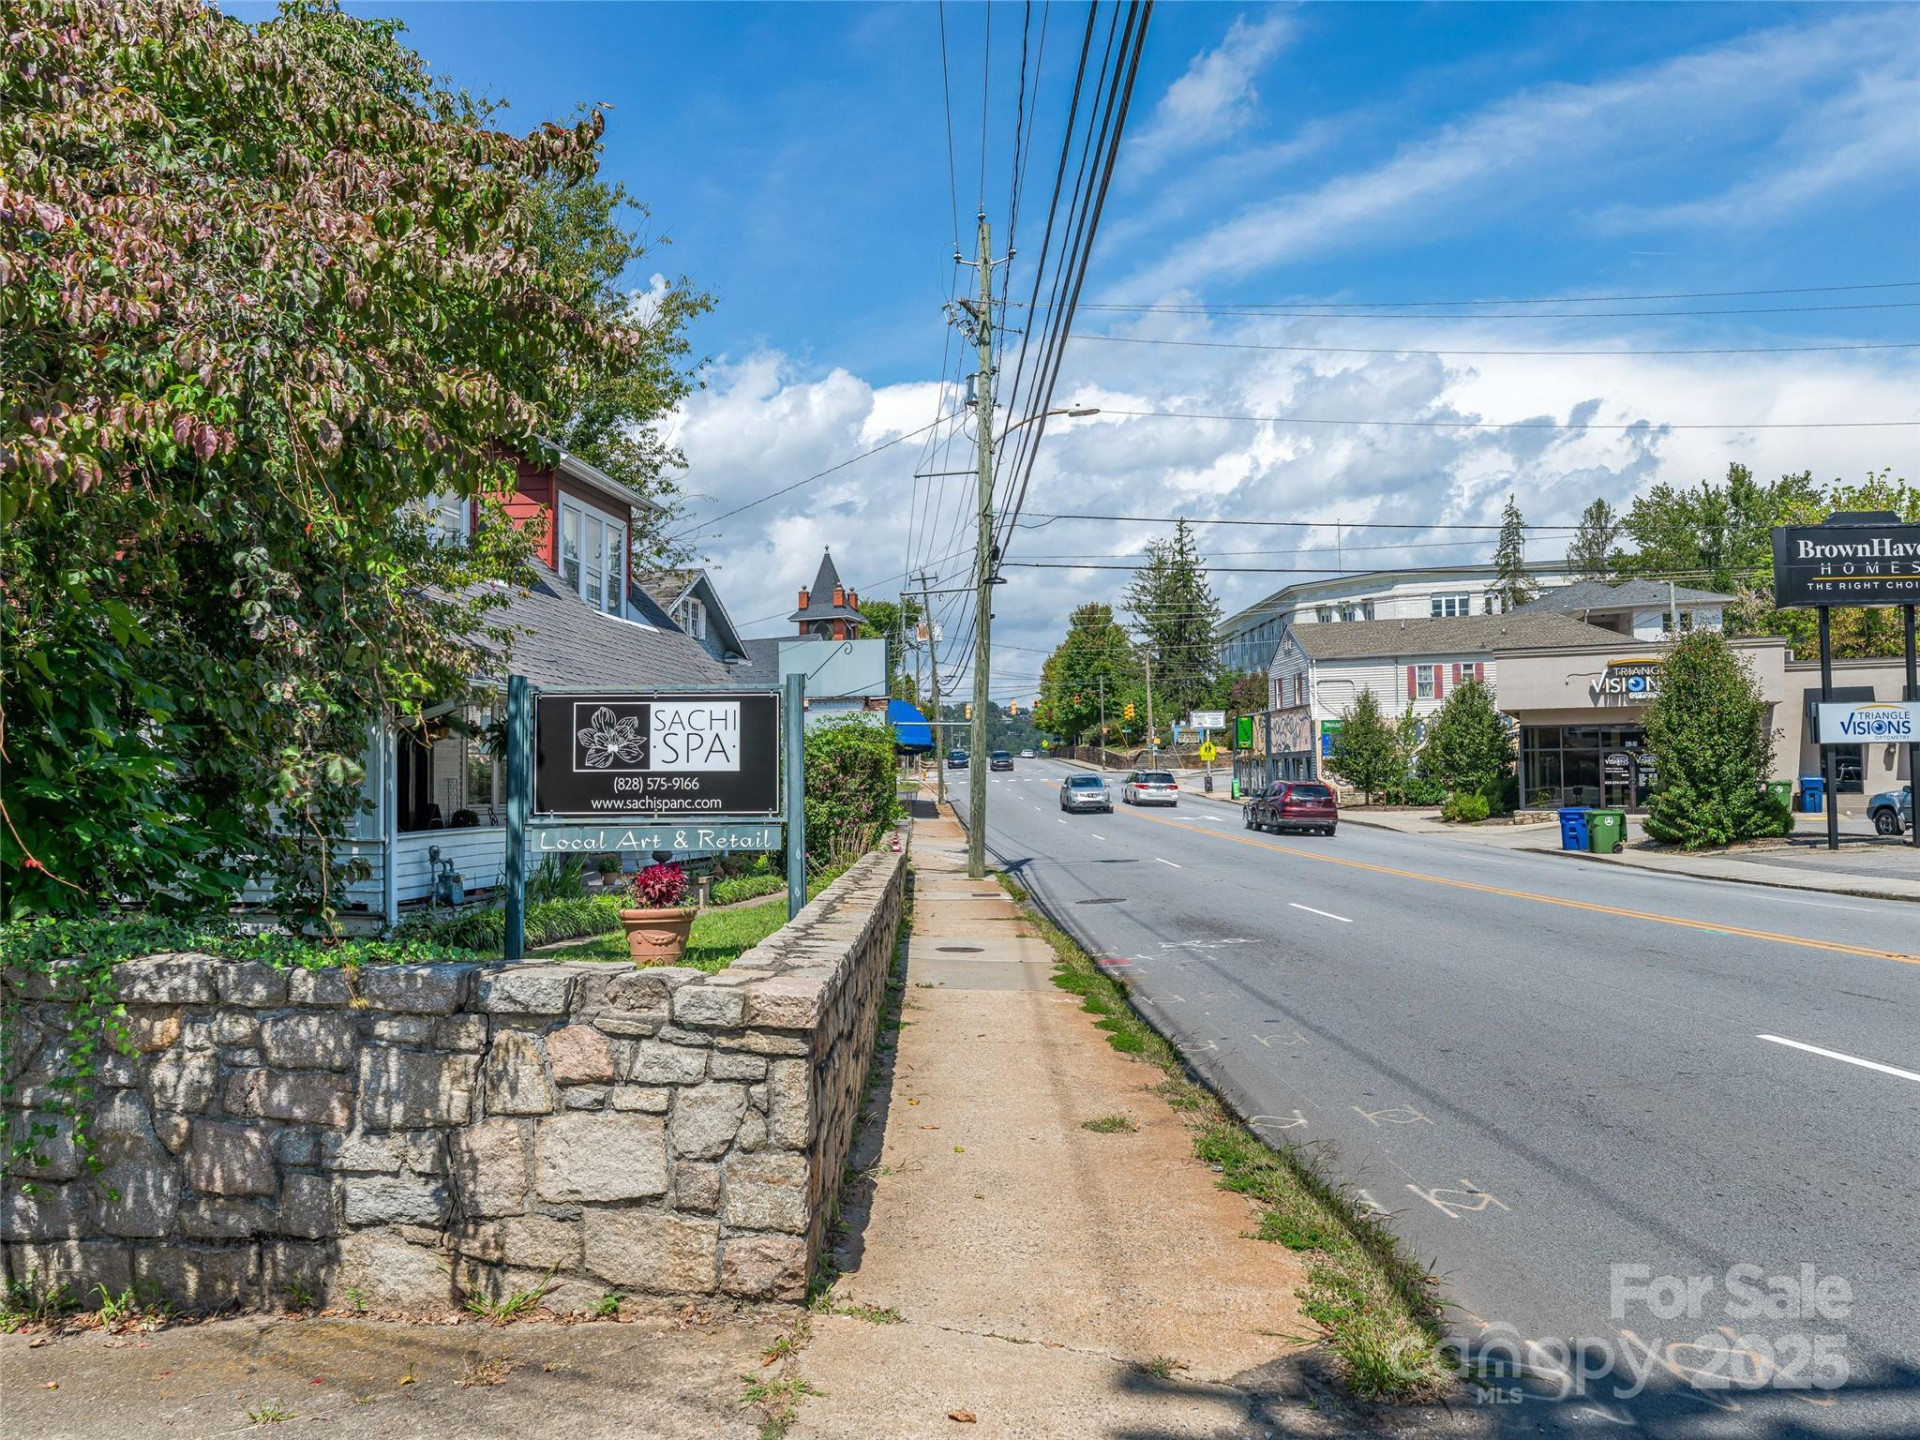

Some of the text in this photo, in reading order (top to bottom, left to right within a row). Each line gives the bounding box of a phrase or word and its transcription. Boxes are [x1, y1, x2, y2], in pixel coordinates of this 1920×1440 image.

[1820, 561, 1920, 575] HOMES
[1807, 582, 1832, 591] THE
[1839, 581, 1880, 590] RIGHT
[1591, 668, 1667, 693] VISION
[653, 709, 737, 732] SACHI
[1840, 712, 1911, 735] VISIONS
[1858, 711, 1910, 720] TRIANGLE
[613, 777, 700, 793] (828) 575-9166
[590, 795, 722, 812] www.sachispanc.com
[540, 829, 772, 850] Local Art & Retail
